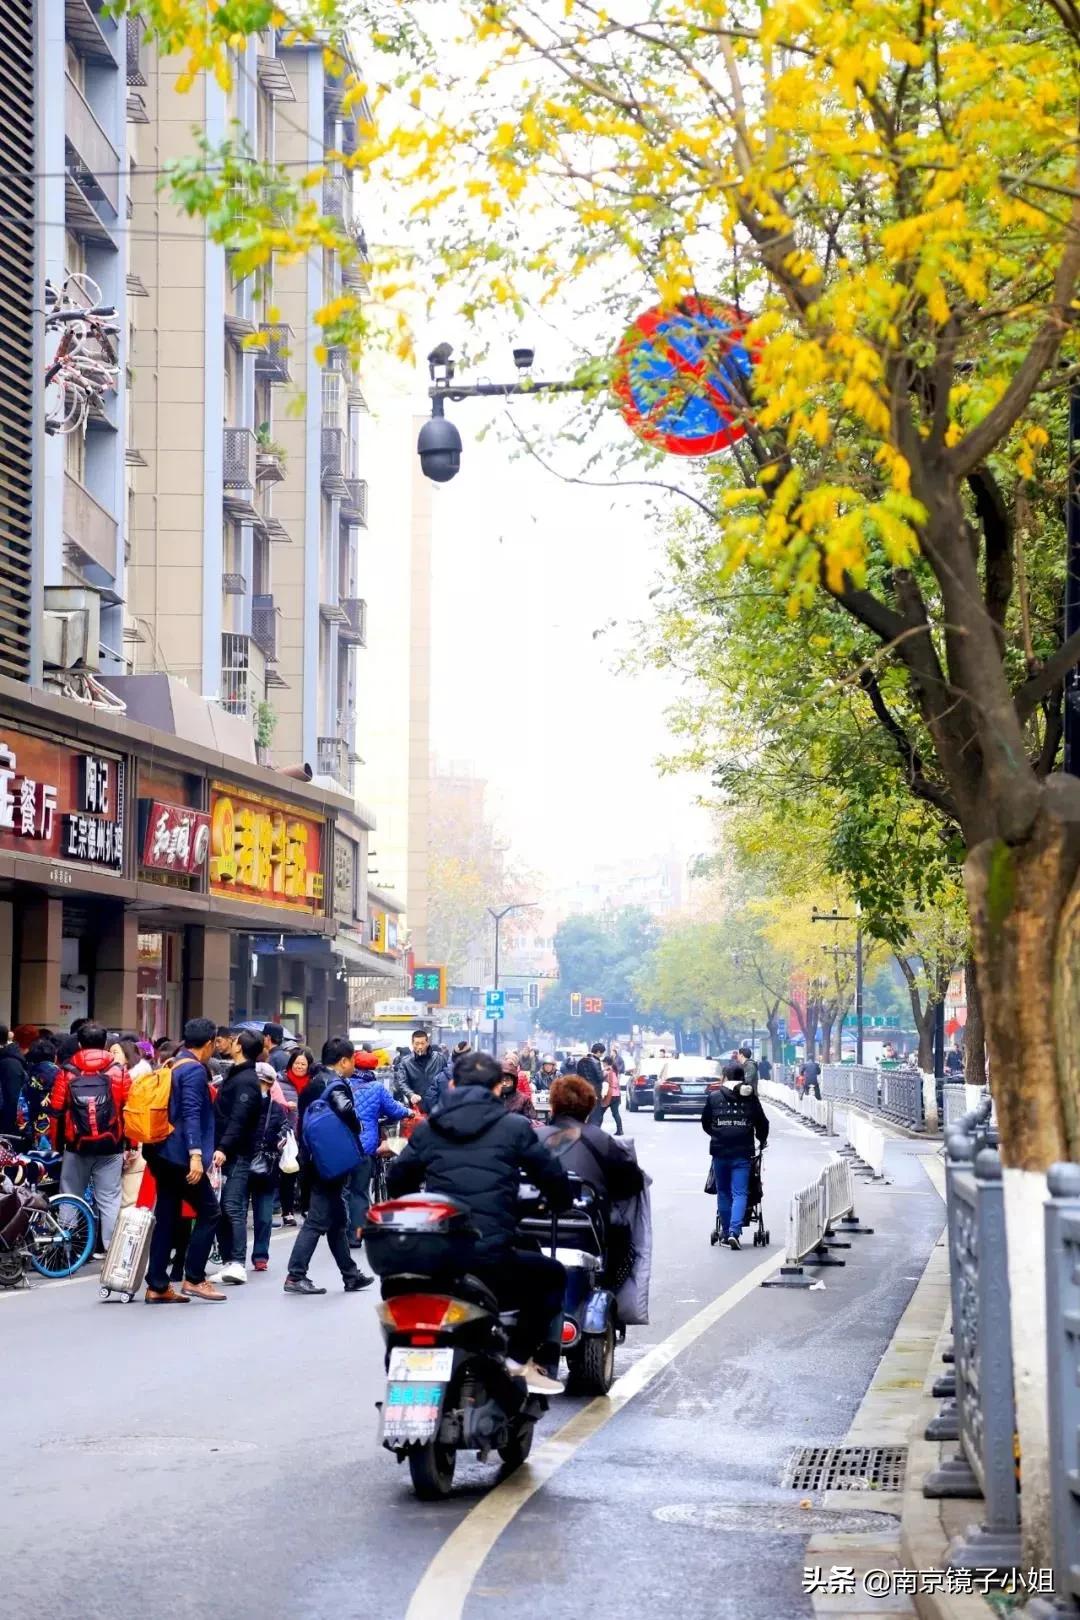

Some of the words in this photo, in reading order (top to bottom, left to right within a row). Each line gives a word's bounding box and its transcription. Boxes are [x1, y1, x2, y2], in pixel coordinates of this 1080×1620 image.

[21, 775, 57, 840] 餐厅
[490, 993, 500, 1005] P
[584, 998, 602, 1013] 32
